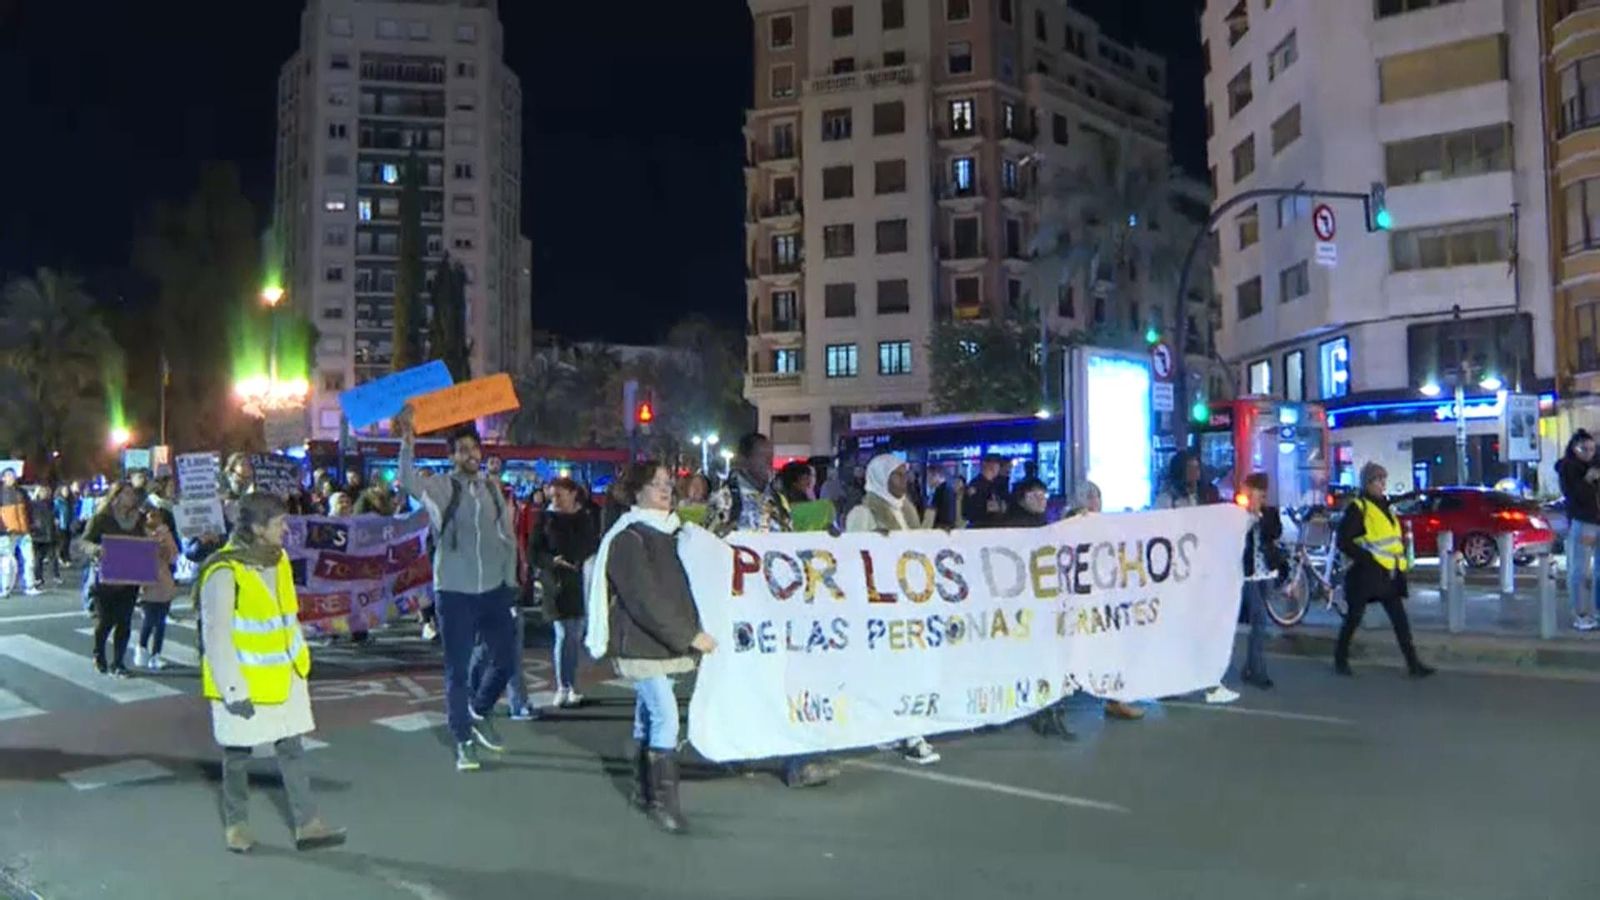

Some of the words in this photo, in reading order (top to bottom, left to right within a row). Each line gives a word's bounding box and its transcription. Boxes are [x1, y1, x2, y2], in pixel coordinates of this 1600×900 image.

[731, 543, 845, 603] POR
[859, 549, 969, 603] LOS
[980, 533, 1198, 599] DERECHOS
[866, 608, 1035, 650] PERSONAS
[893, 692, 941, 717] SER
